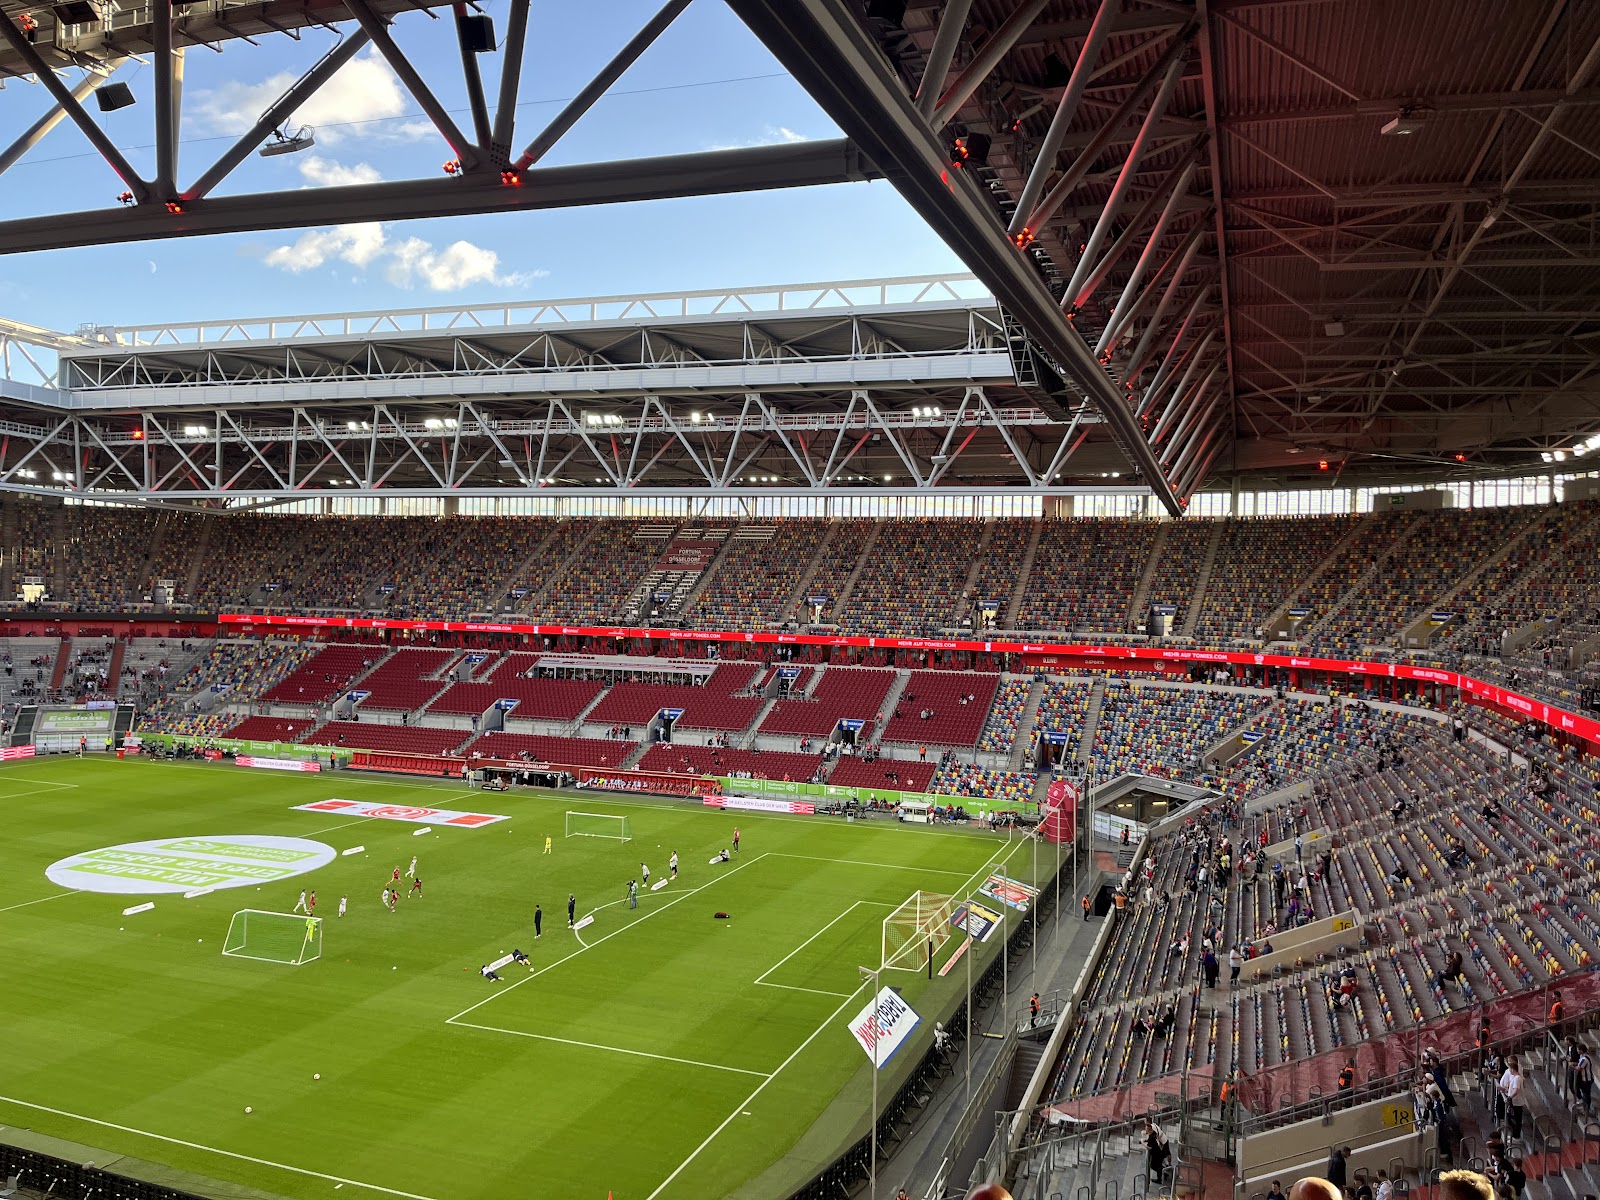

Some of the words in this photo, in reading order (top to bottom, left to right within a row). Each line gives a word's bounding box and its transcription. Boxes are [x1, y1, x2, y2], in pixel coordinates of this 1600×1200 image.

[83, 863, 165, 877] voller
[176, 860, 285, 878] Energie
[162, 872, 219, 884] Mit
[856, 994, 907, 1051] TARGOBANK
[1392, 1109, 1409, 1125] 18
